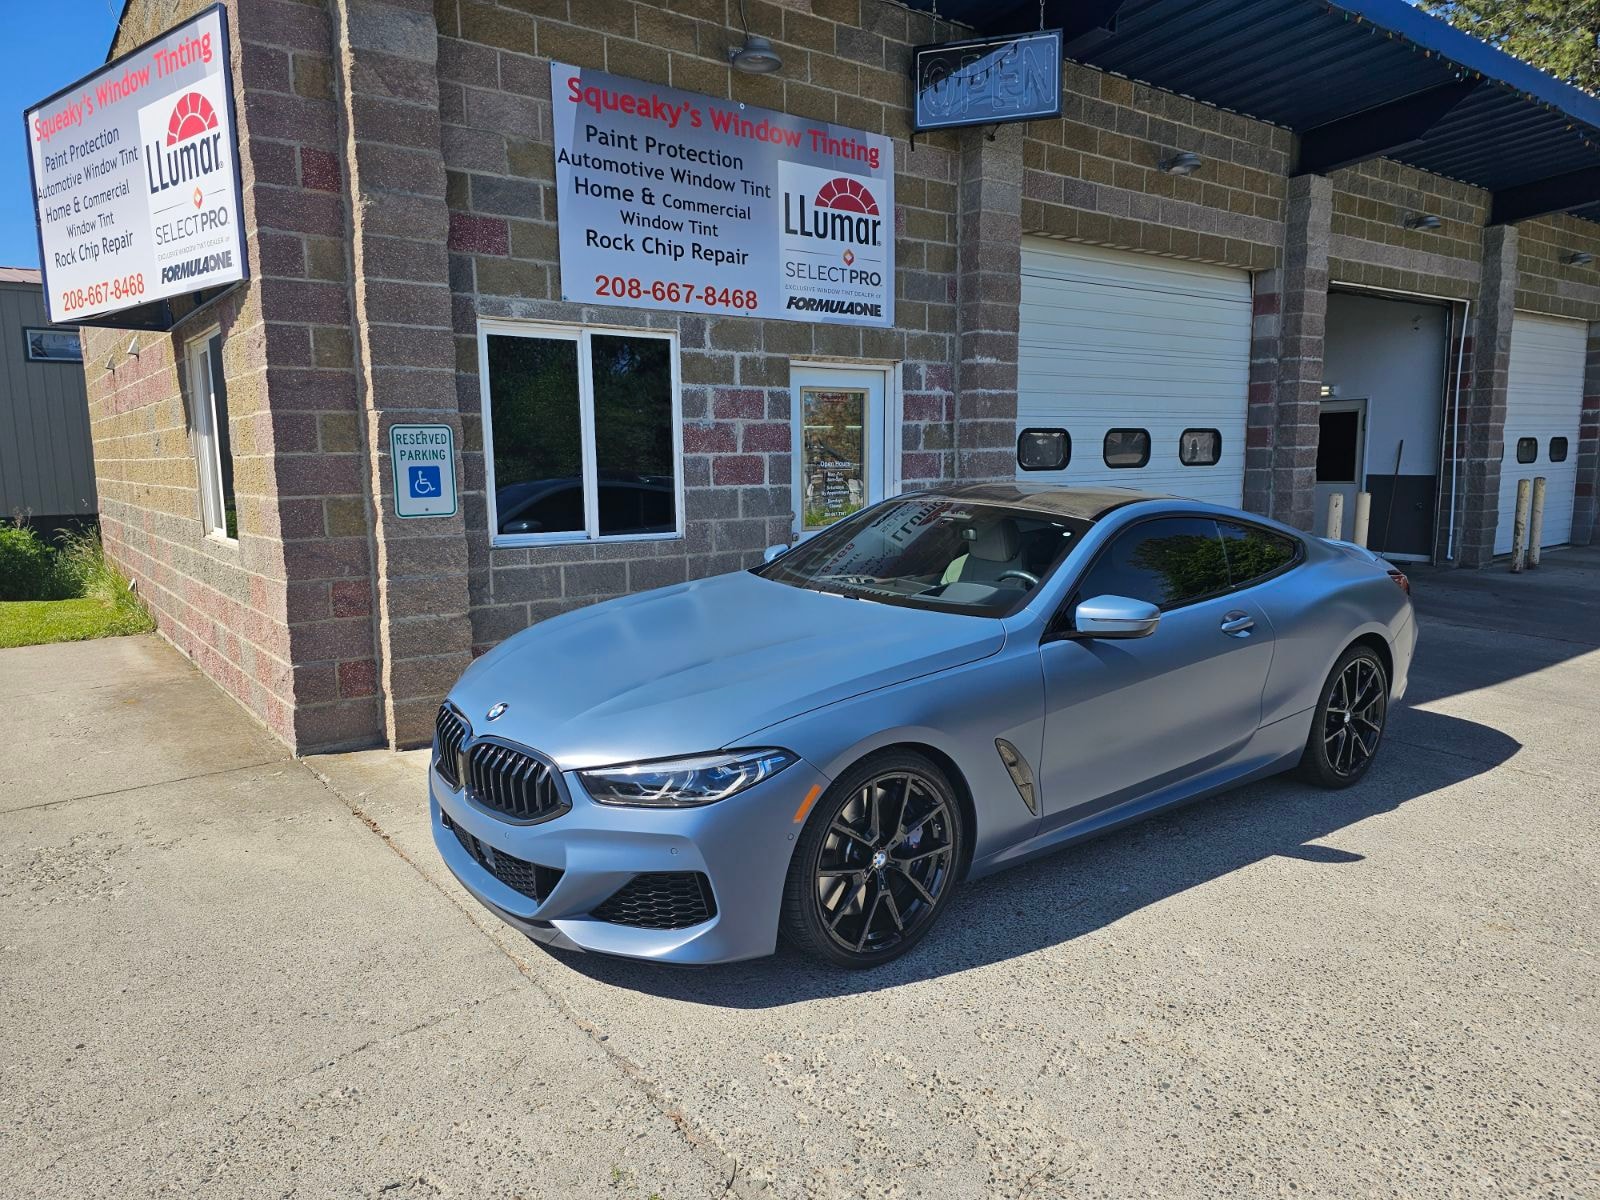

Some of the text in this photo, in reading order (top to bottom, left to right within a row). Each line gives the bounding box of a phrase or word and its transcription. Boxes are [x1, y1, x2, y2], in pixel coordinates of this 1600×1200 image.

[34, 32, 212, 143] Squeaky's Window Tinting
[922, 44, 1055, 117] OPEN
[567, 76, 880, 169] Squeaky's Window Tinting
[45, 127, 120, 173] Paint Protection
[145, 132, 221, 194] LLumar
[586, 124, 743, 170] Paint Protection
[38, 146, 139, 200] Automotive Window Tint
[557, 147, 772, 199] Automotive Window Tint
[45, 179, 130, 224] Home & Commercial
[574, 175, 751, 220] Home & Commercial
[784, 192, 881, 246] LLumar
[66, 211, 115, 239] Window Tint
[619, 209, 719, 237] Window Tint
[54, 230, 134, 269] Rock Chip Repair
[586, 229, 749, 266] Rock Chip Repair
[62, 272, 145, 312] 208-667-8468
[595, 274, 758, 310] 208-667-8468
[784, 283, 815, 292] EXCLUSIVE
[817, 287, 840, 295] WINDOW
[395, 433, 447, 445] RESERVED
[400, 449, 446, 461] PARKING
[820, 460, 850, 468] Open Hours
